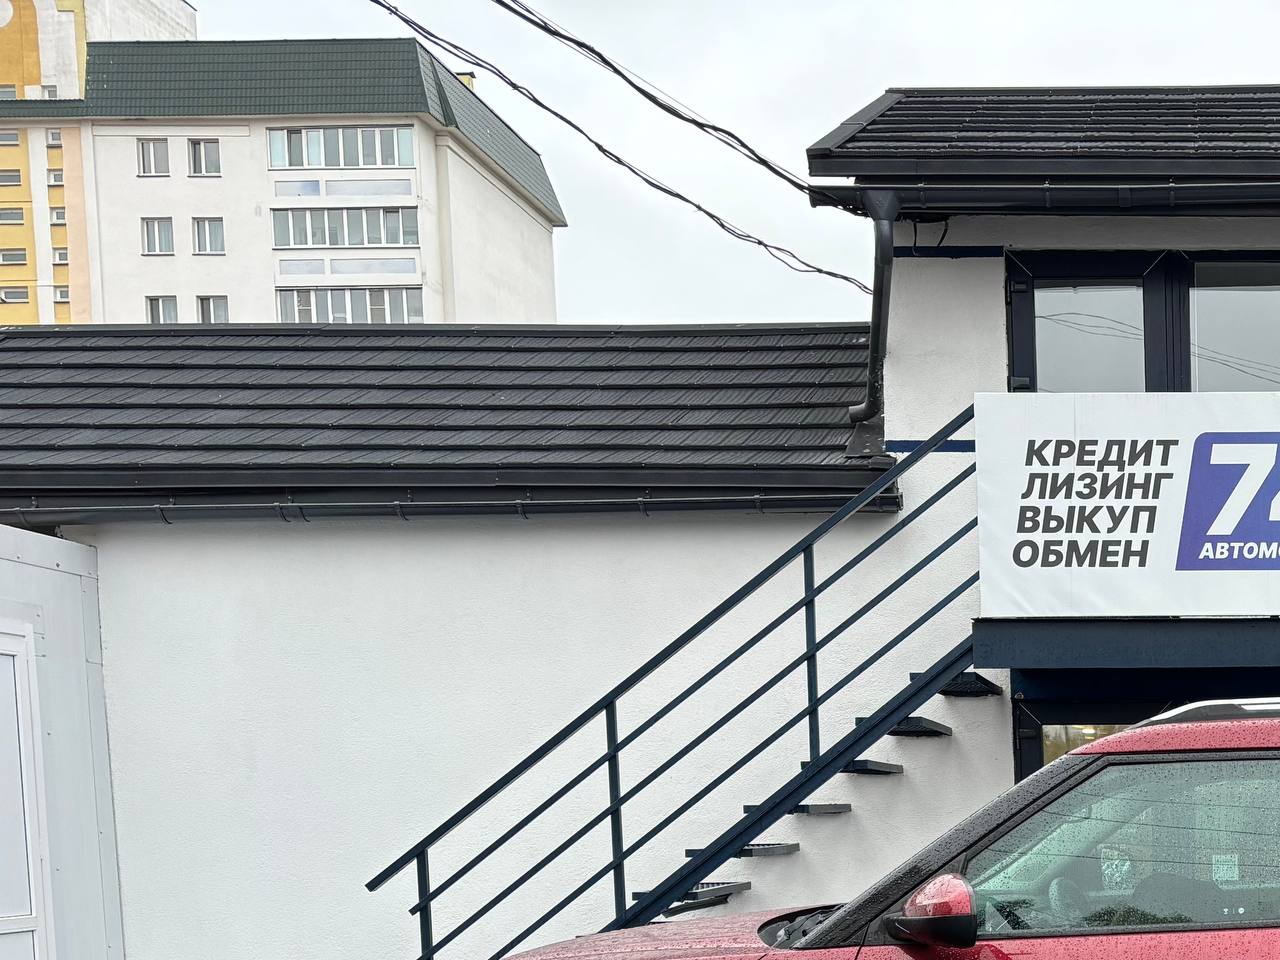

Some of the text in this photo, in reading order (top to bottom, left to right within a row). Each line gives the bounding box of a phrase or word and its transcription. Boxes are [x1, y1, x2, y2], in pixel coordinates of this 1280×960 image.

[1026, 439, 1179, 471] КРЕДИТ
[1021, 472, 1173, 500] ЛИЗИНГ
[1016, 505, 1156, 534] ВЫКУП
[1012, 539, 1148, 568] ОБМЕН
